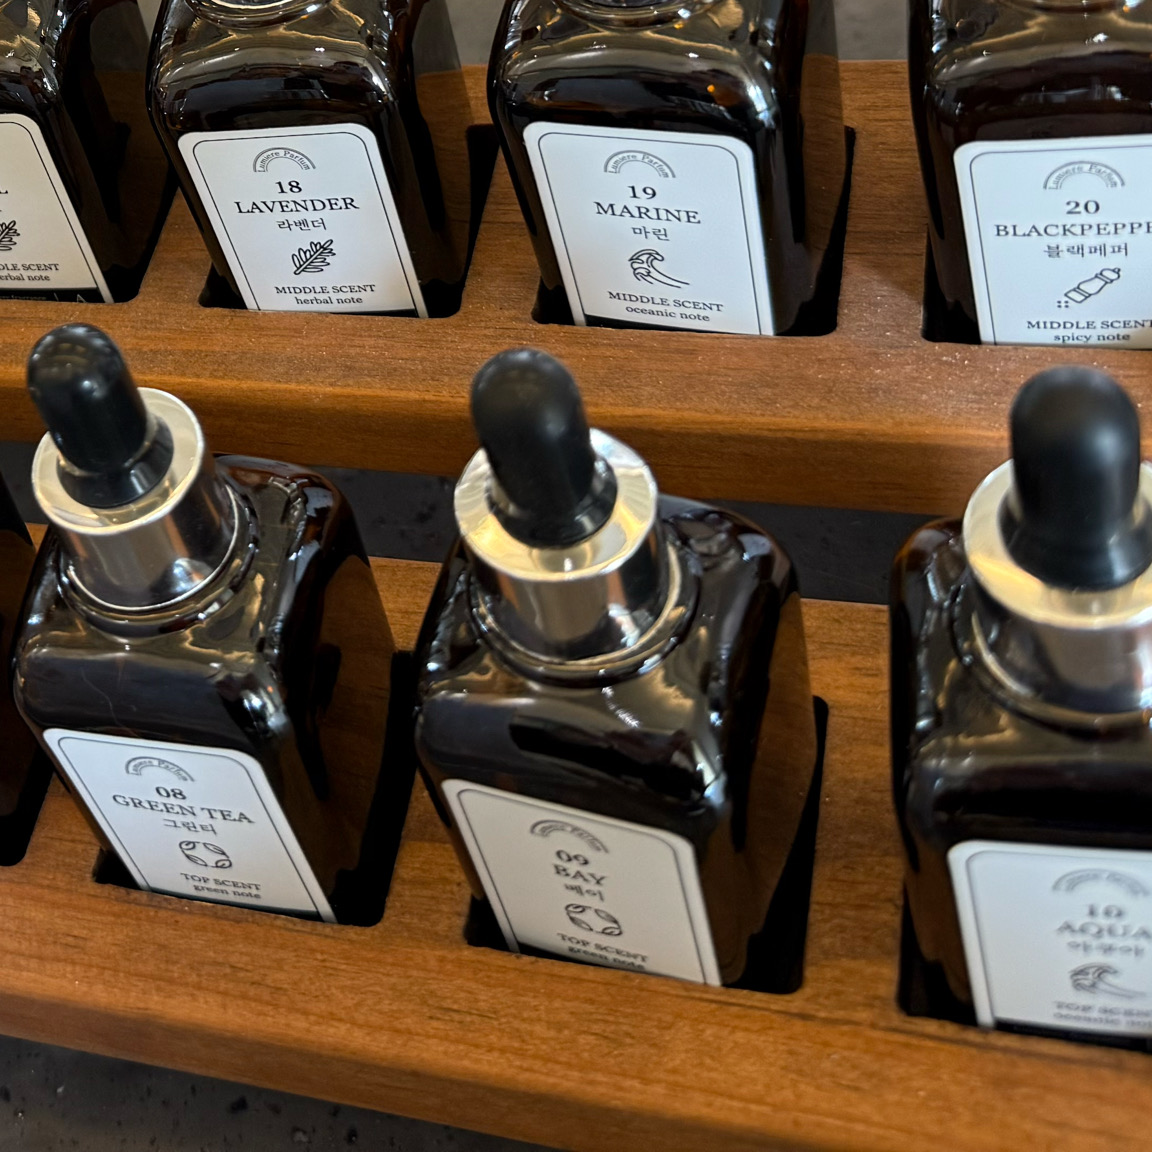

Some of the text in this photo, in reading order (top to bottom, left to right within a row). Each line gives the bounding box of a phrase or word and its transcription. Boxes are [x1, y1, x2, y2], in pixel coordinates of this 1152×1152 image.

[284, 150, 310, 171] Parfum
[276, 181, 302, 194] 18
[628, 186, 657, 199] 19
[235, 197, 360, 214] LAVENDER
[594, 202, 701, 224] MARINE
[1066, 200, 1100, 214] 20
[276, 218, 327, 231] 라벤더
[632, 226, 670, 241] 마린
[1044, 243, 1129, 258] 블랙페퍼
[21, 263, 59, 271] SCENT
[275, 285, 376, 294] MIDDLE SCENT
[294, 297, 333, 305] herbal
[608, 291, 723, 312] MIDDLE SCENT
[626, 306, 710, 322] oceanic note
[1026, 321, 1096, 329] MIDDLE
[1054, 333, 1130, 344] spicy note
[155, 786, 187, 800] 08
[113, 794, 255, 823] GREEN TEA
[164, 819, 218, 835] 그린티
[555, 850, 589, 866] 09
[181, 873, 261, 891] TOP SCENT
[553, 864, 607, 886] BAY
[193, 884, 261, 898] green note
[1087, 904, 1124, 918] 10
[1057, 920, 1152, 938] AQUA
[557, 933, 647, 962] TOP SCENT
